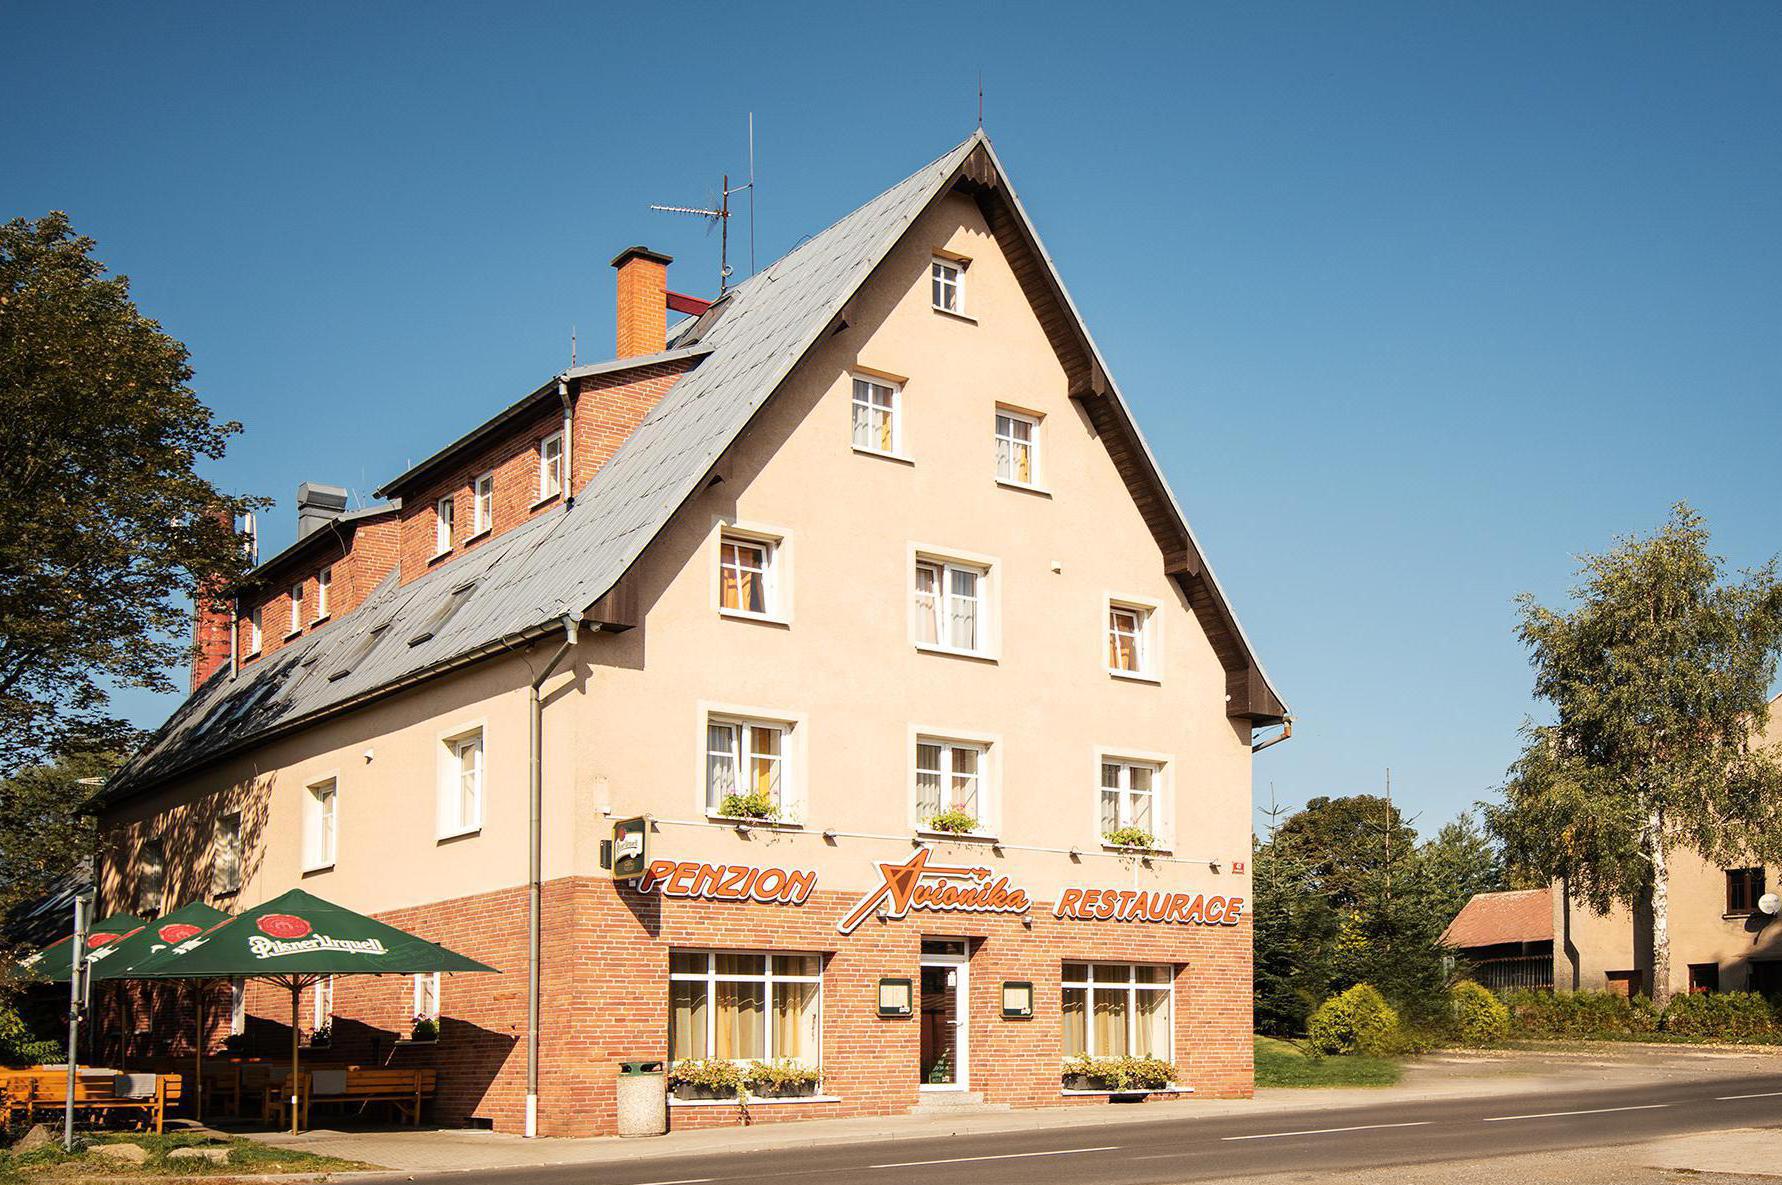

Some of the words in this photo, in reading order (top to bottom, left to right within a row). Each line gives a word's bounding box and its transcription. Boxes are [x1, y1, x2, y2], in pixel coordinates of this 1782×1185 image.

[639, 860, 817, 903] PENZION
[840, 847, 1030, 930] Avionika
[1055, 888, 1244, 924] RESTAURACE
[248, 935, 320, 959] Pilsner
[312, 933, 388, 955] Urquell
